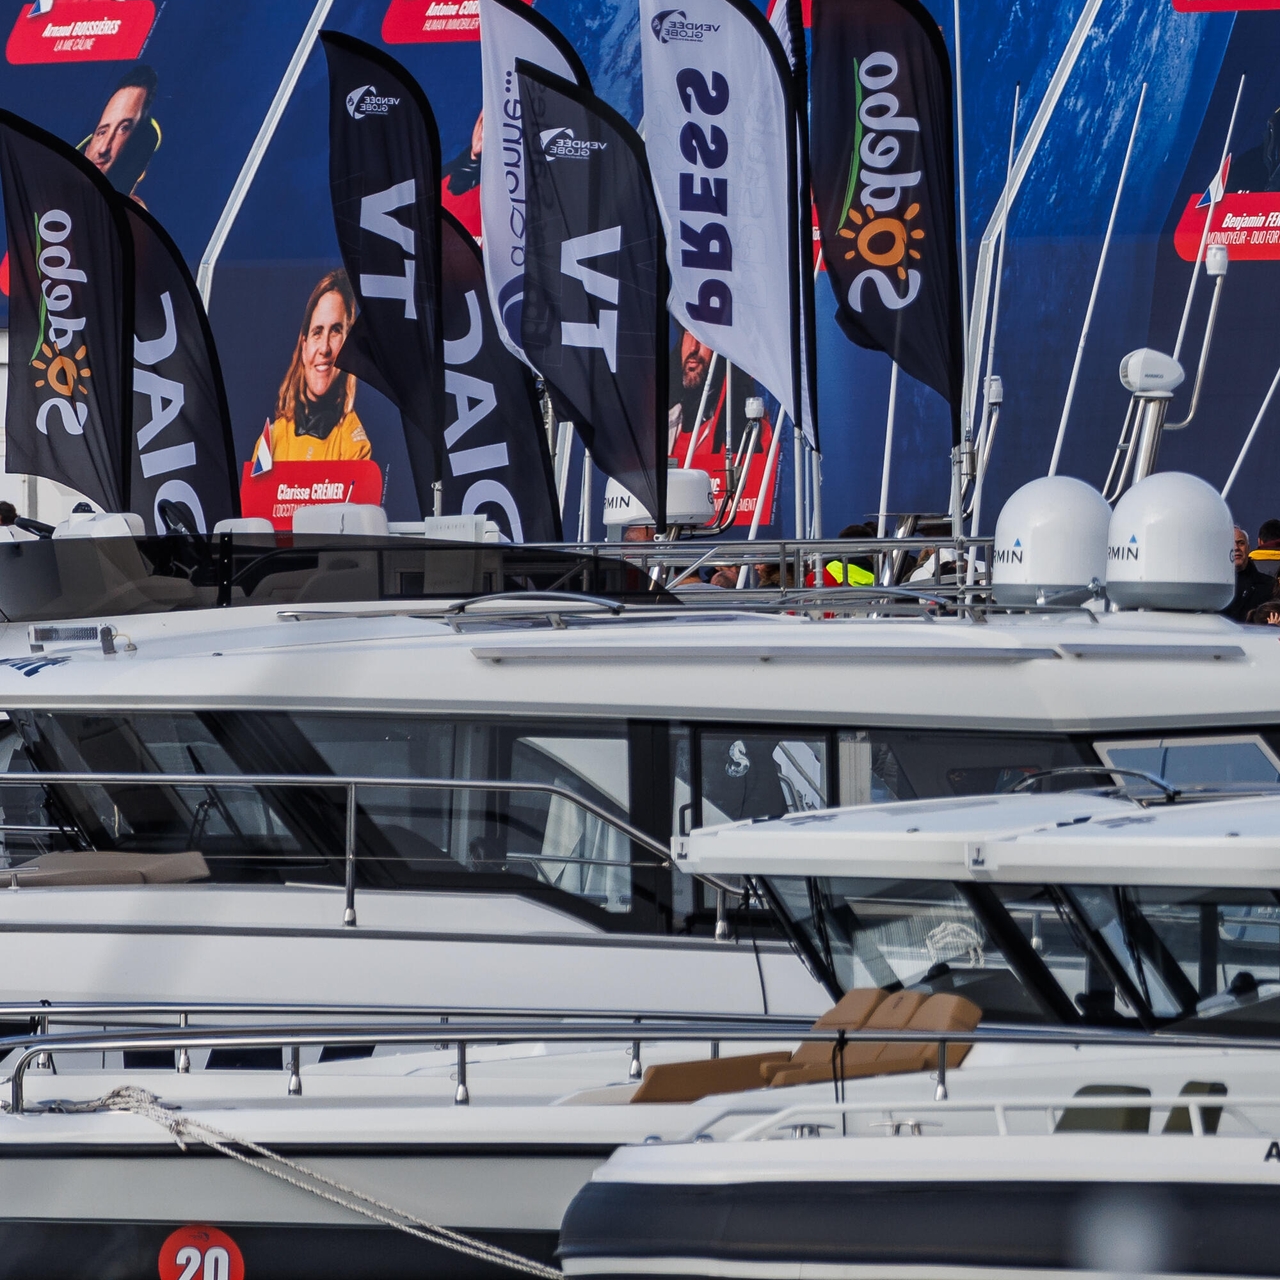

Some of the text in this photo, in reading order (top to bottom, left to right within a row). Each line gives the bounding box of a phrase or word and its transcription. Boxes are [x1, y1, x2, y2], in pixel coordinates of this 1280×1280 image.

[425, 1, 459, 17] Antoine
[41, 23, 74, 38] Arnaud
[1221, 213, 1266, 230] Benjamin
[1250, 231, 1266, 244] DUO
[1265, 230, 1280, 244] FOR
[277, 478, 344, 501] Clarisse CRÉMER
[175, 1246, 230, 1280] 20
